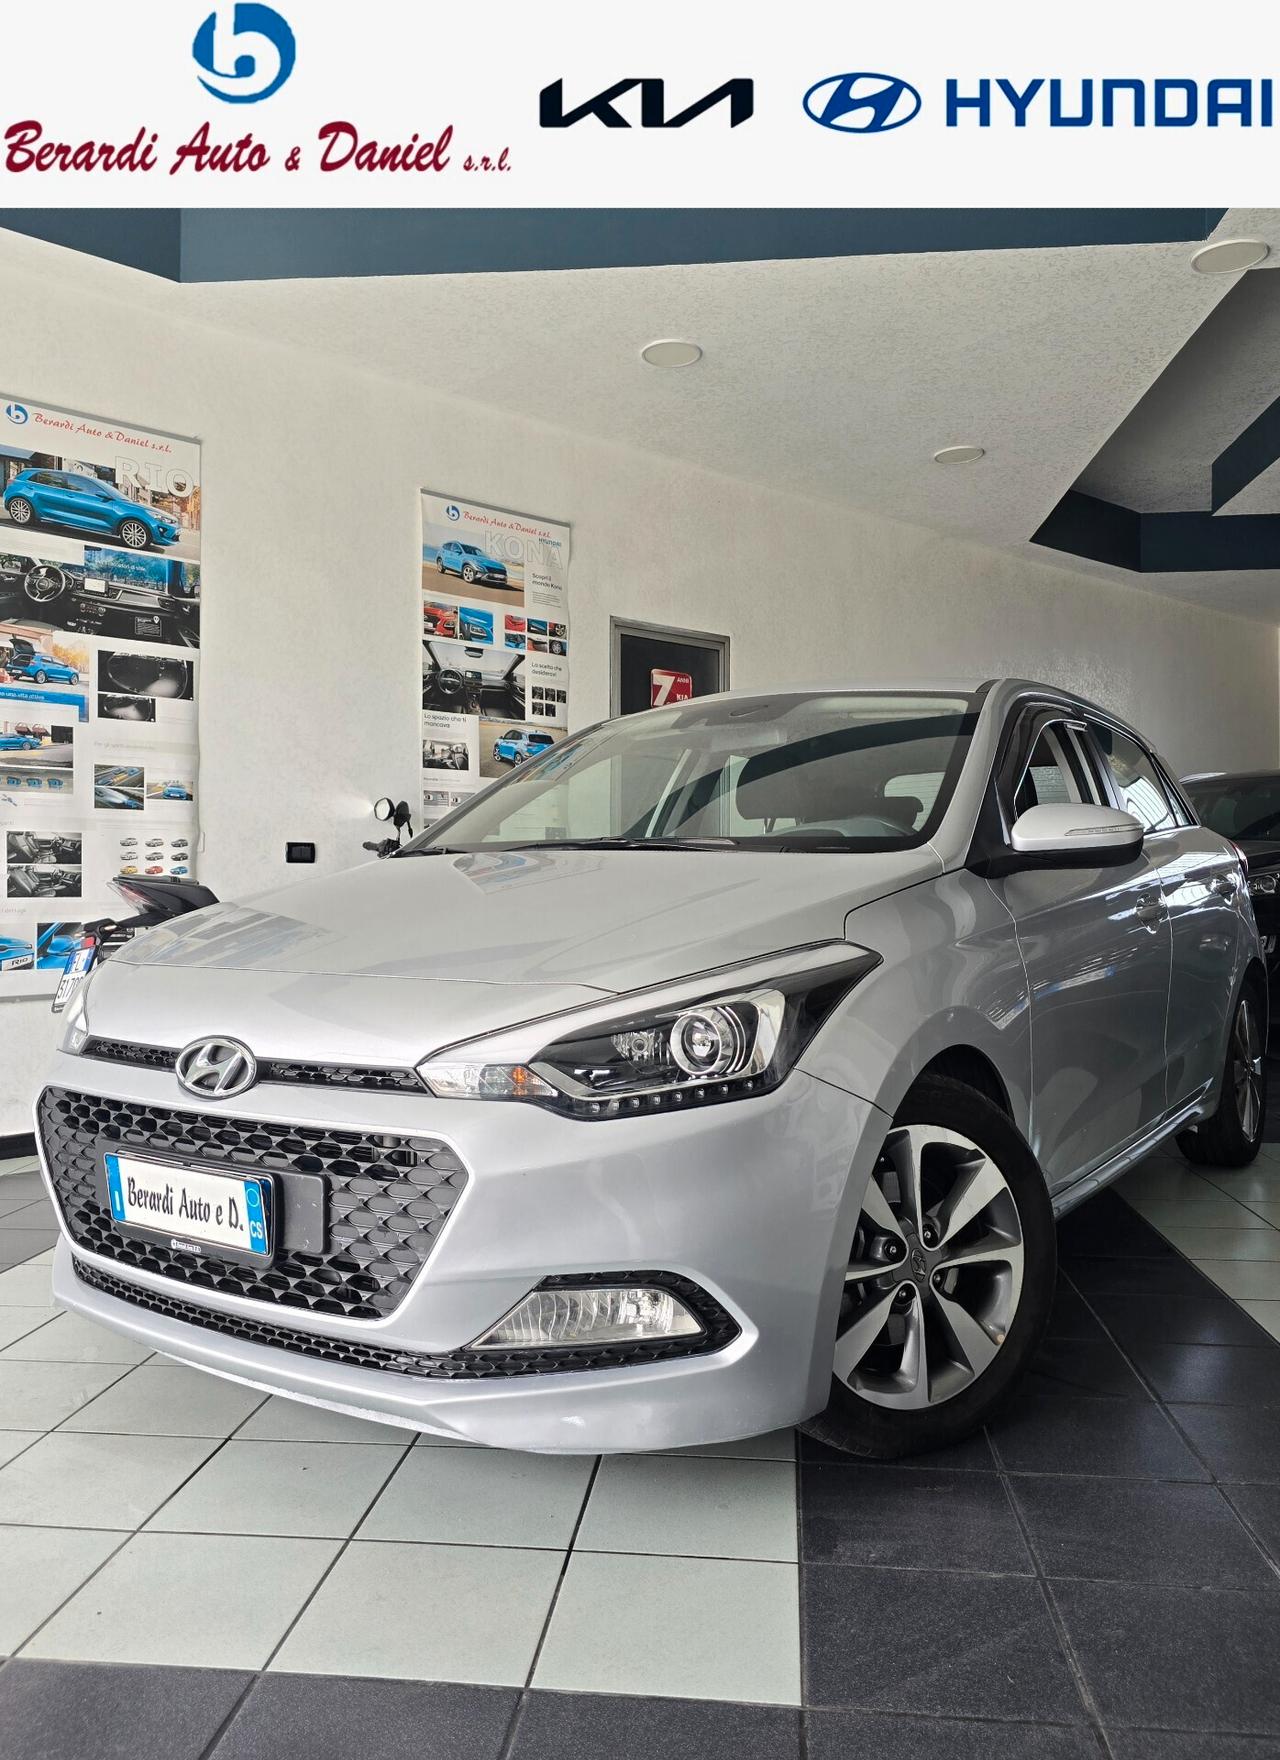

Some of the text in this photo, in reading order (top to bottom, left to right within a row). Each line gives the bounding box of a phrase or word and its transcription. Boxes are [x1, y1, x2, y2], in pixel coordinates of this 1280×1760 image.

[33, 412, 73, 431] Berardi
[75, 424, 102, 437] Auto
[105, 431, 113, 440] &
[114, 431, 149, 448] Daniel
[115, 455, 194, 498] RIO
[463, 510, 489, 525] Berardi
[489, 517, 507, 529] Auto
[514, 522, 537, 535] Daniel
[484, 530, 563, 569] KONA
[653, 674, 676, 706] 7
[127, 1177, 244, 1232] Berardi Auto e D.
[249, 1220, 263, 1240] CS
